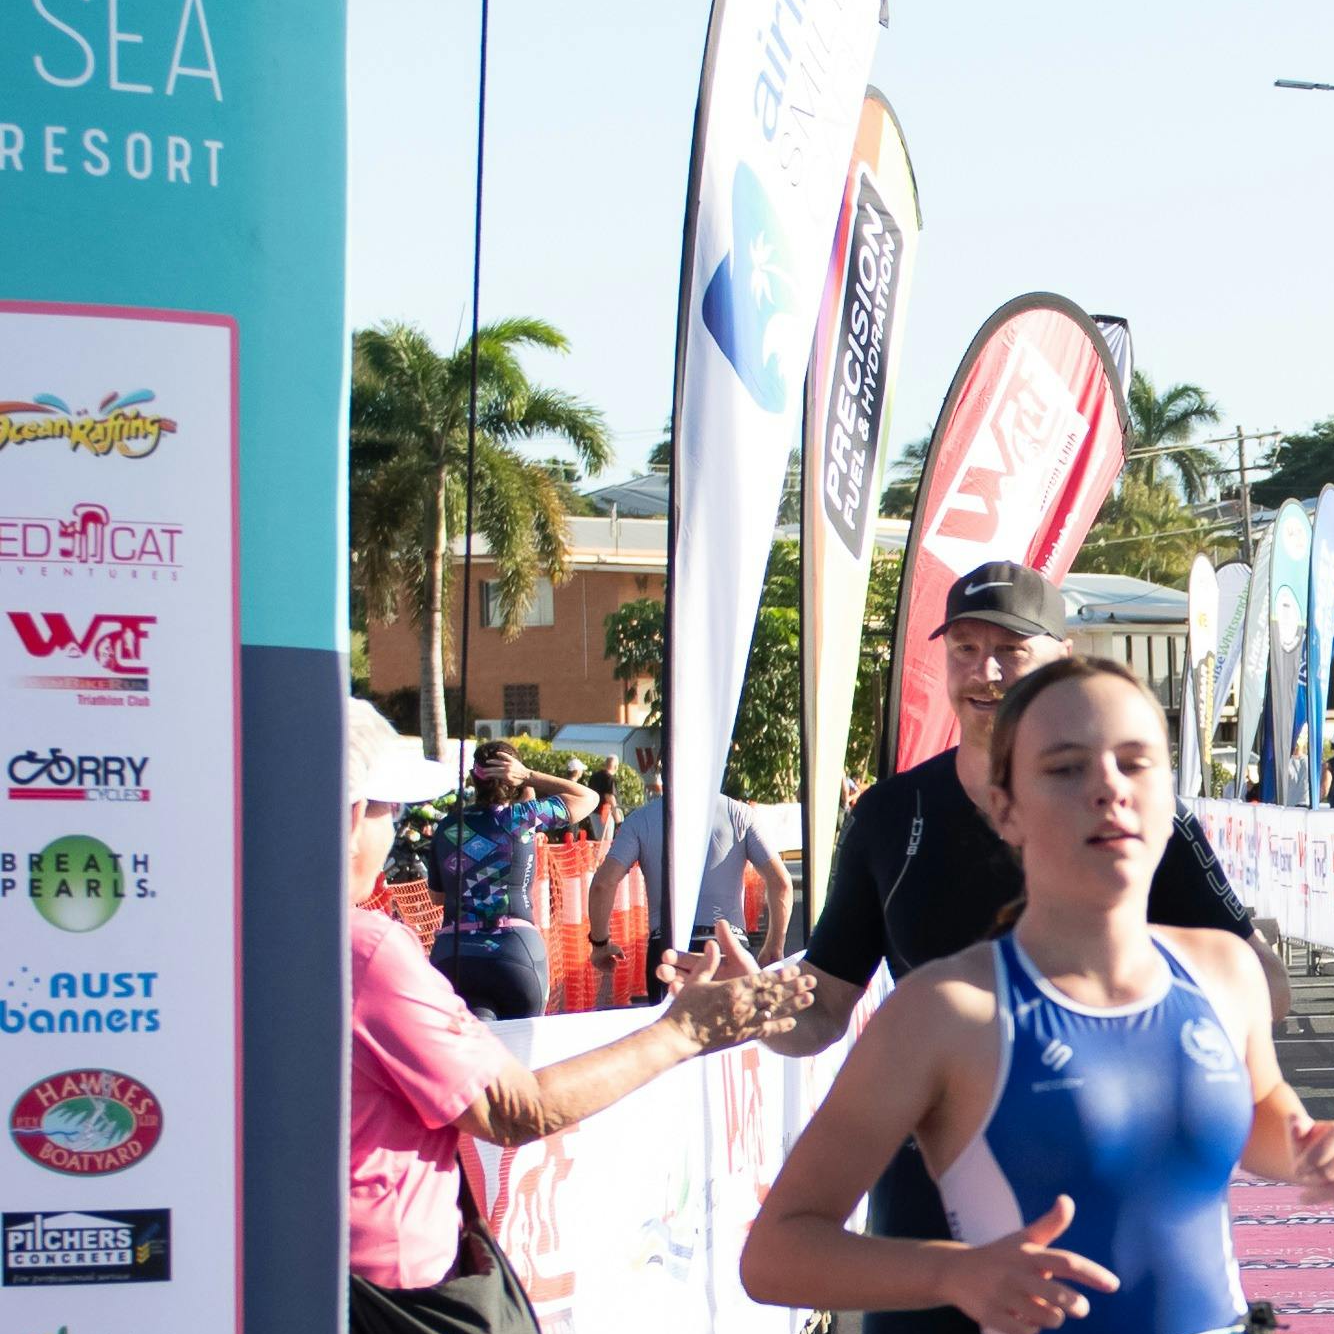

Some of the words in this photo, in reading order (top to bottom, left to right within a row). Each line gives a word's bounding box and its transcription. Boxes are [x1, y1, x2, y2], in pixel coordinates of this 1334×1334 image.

[0, 123, 225, 187] RESORT
[826, 202, 884, 512] PRECISION
[842, 449, 867, 531] FUEL
[860, 230, 896, 416] HYDRATION
[110, 526, 184, 563] CAT
[1, 853, 150, 873] BREATH
[49, 972, 159, 999] AUST
[0, 999, 161, 1034] banners
[34, 1073, 154, 1116] HAWKES
[38, 1140, 143, 1171] BOATYARD
[14, 1251, 127, 1265] CONCRETE
